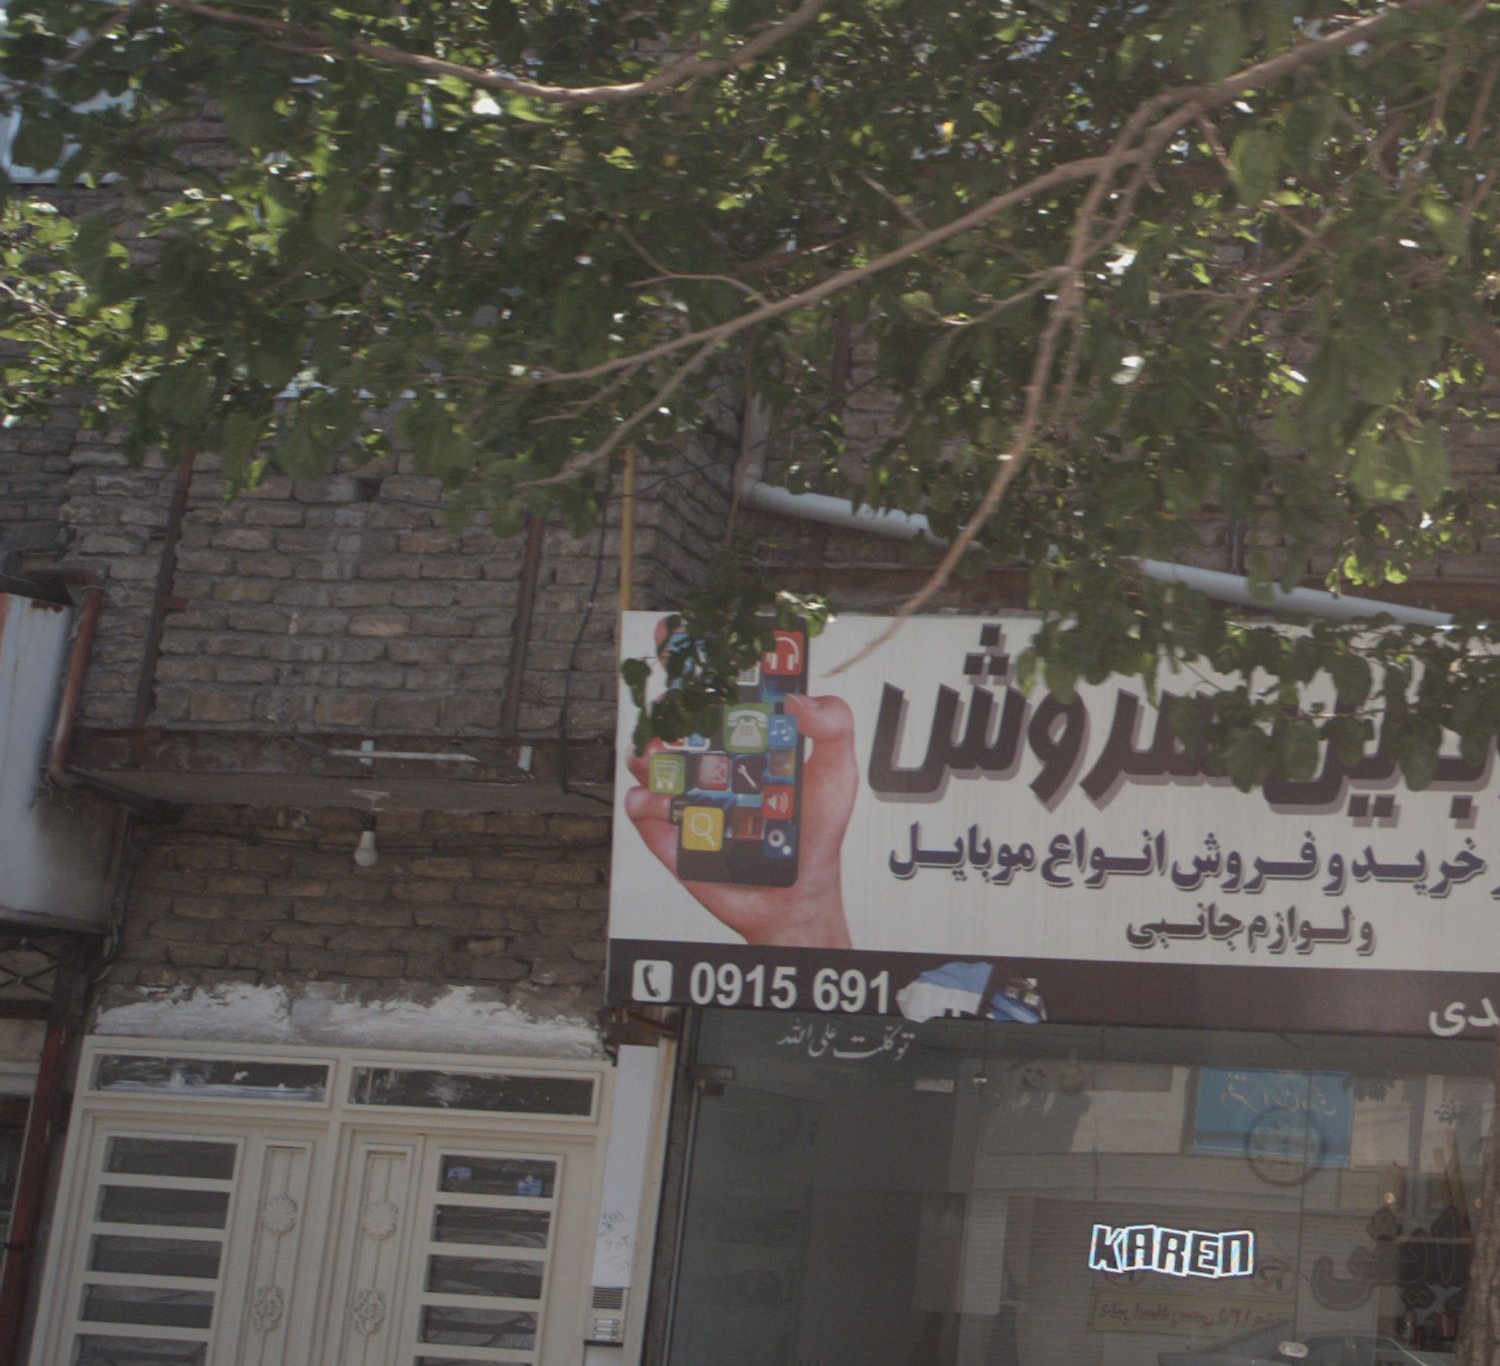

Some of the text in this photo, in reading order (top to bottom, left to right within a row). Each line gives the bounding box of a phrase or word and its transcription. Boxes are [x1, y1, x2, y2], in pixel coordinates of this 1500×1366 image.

[888, 821, 1036, 885] موبایل
[1042, 827, 1168, 889] انواع
[1172, 829, 1319, 895] فروش
[1322, 852, 1347, 895] و
[1352, 836, 1487, 899] خرید
[1126, 901, 1376, 956] و لوازم جانبی
[690, 961, 798, 1009] 0915
[812, 968, 890, 1014] 691
[1088, 1223, 1256, 1279] KAREN
